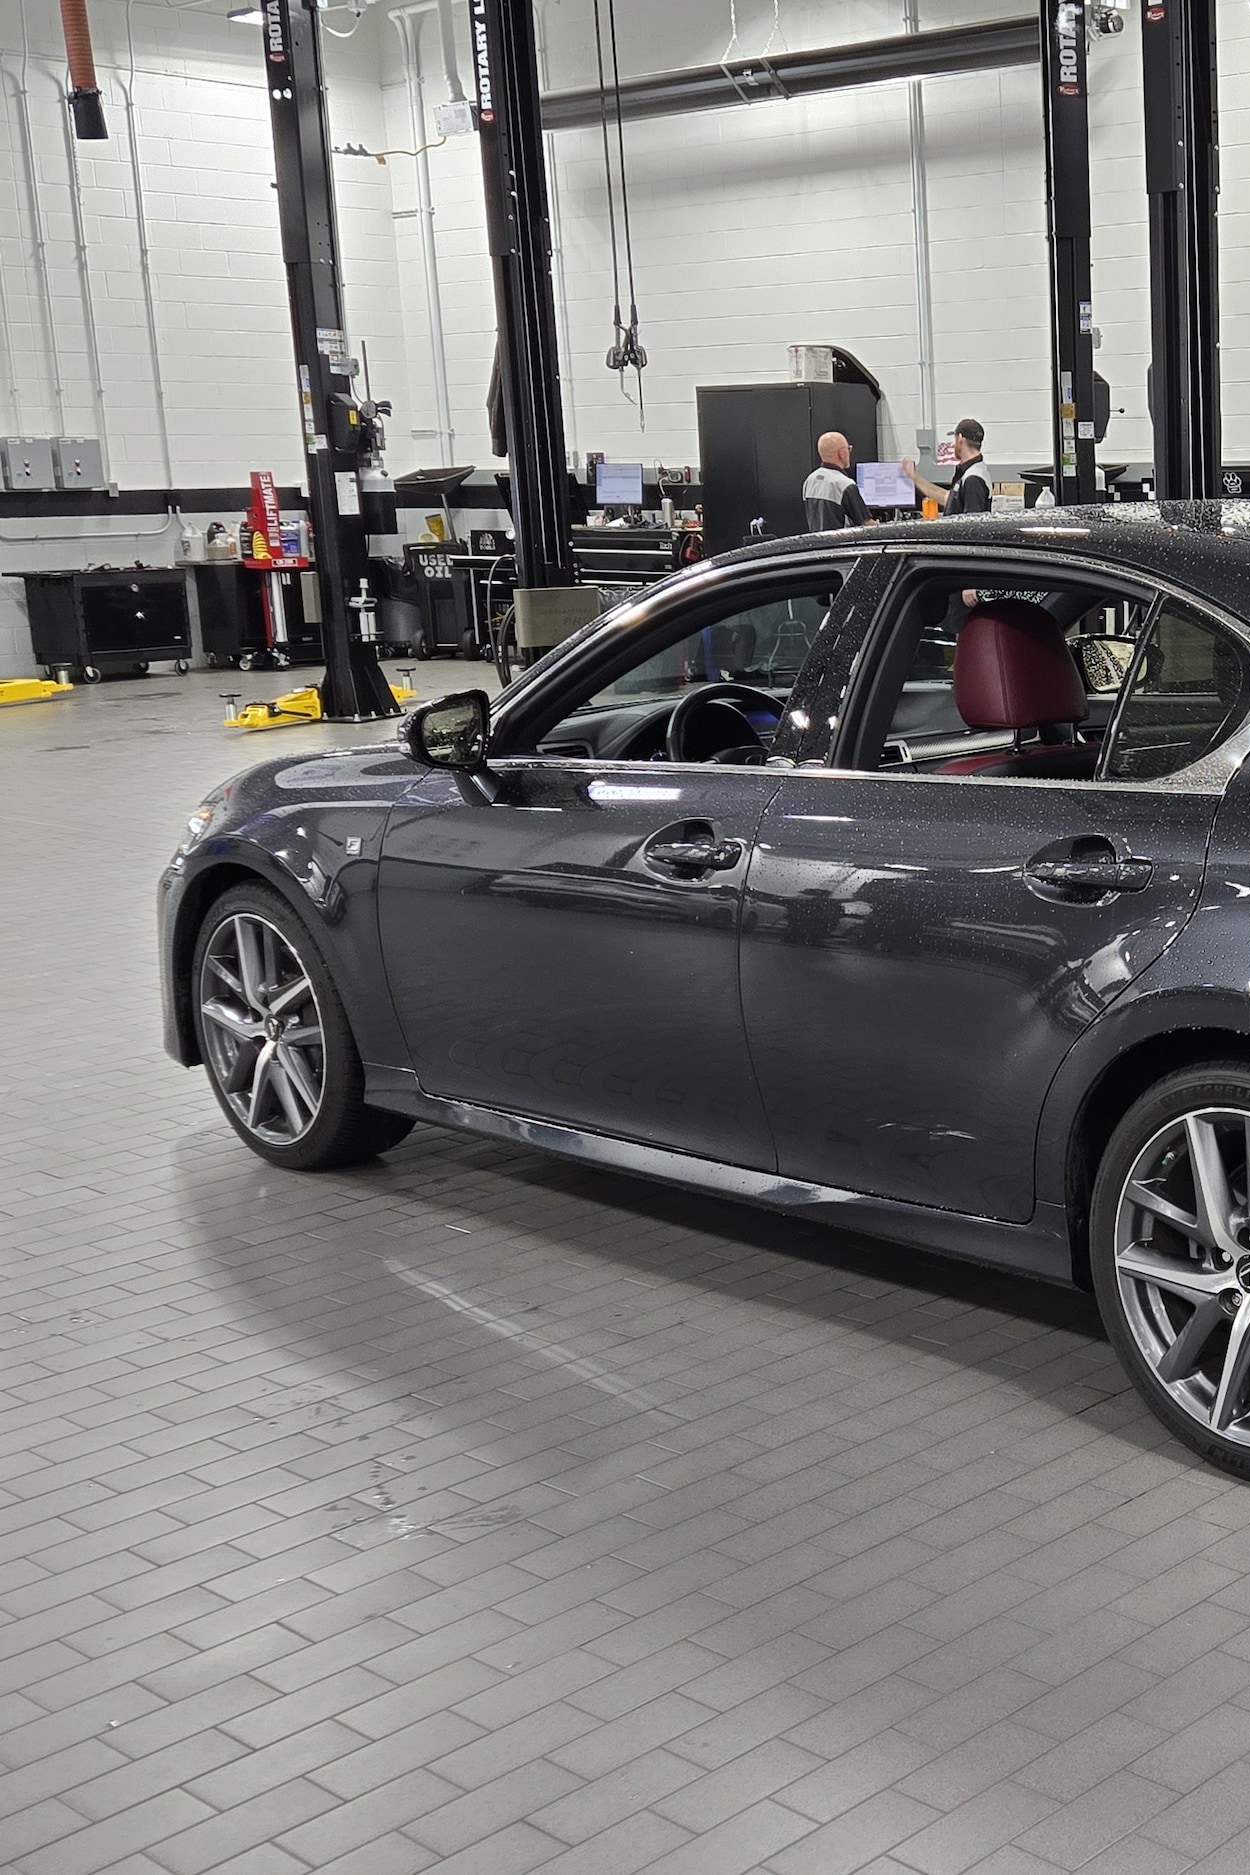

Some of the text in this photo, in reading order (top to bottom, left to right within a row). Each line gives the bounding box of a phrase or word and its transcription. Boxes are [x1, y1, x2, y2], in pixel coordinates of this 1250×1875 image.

[474, 20, 493, 109] ROTARY
[260, 475, 279, 527] LIFTMATE
[424, 566, 452, 578] OIL
